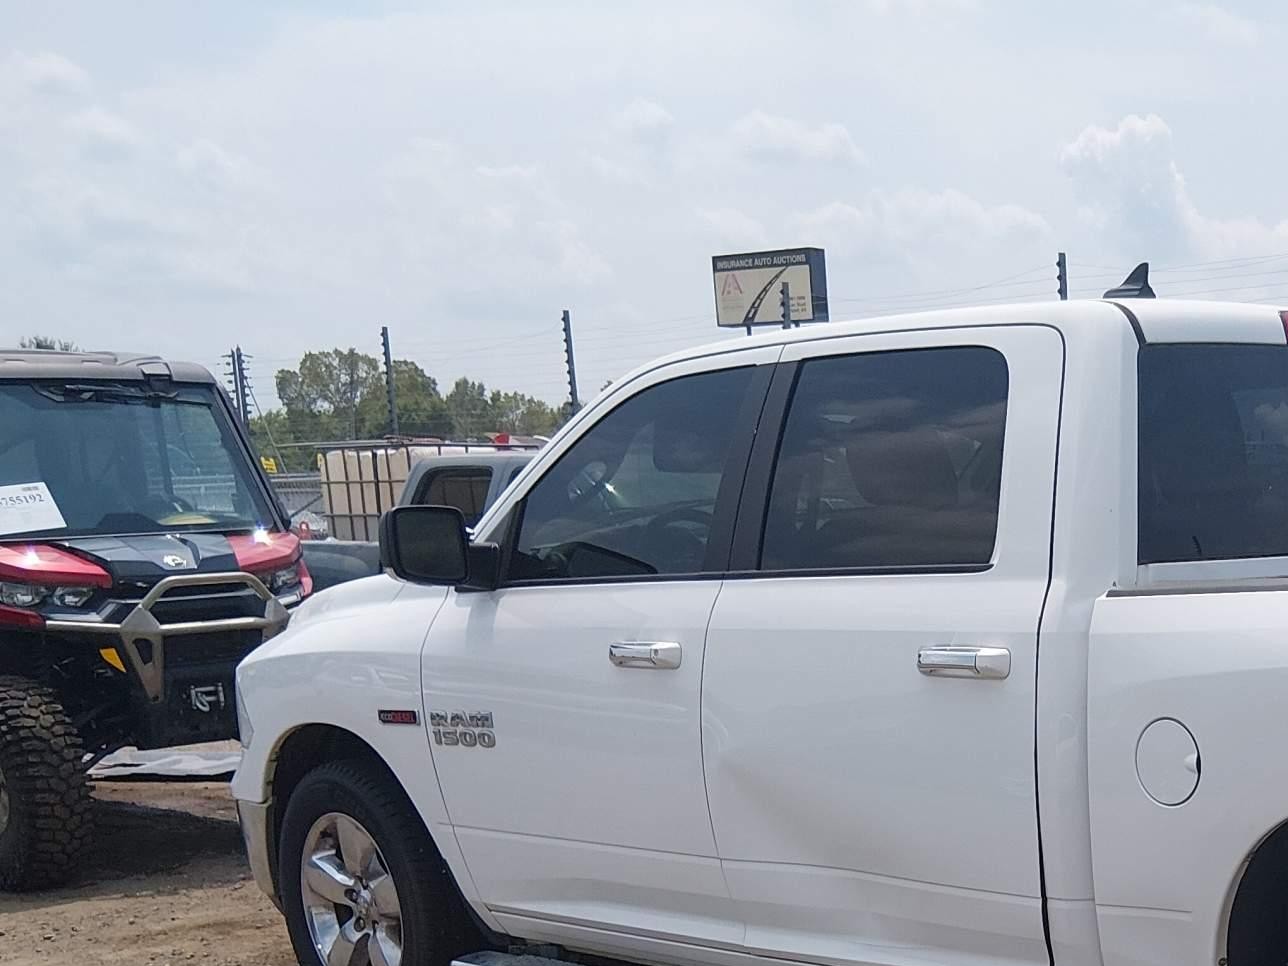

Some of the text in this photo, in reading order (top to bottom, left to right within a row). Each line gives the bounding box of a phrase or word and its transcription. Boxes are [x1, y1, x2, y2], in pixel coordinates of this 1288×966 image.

[717, 254, 806, 269] INSURANCE AUTO AUCTIONS
[430, 711, 494, 729] RAM
[432, 728, 497, 748] 1500
